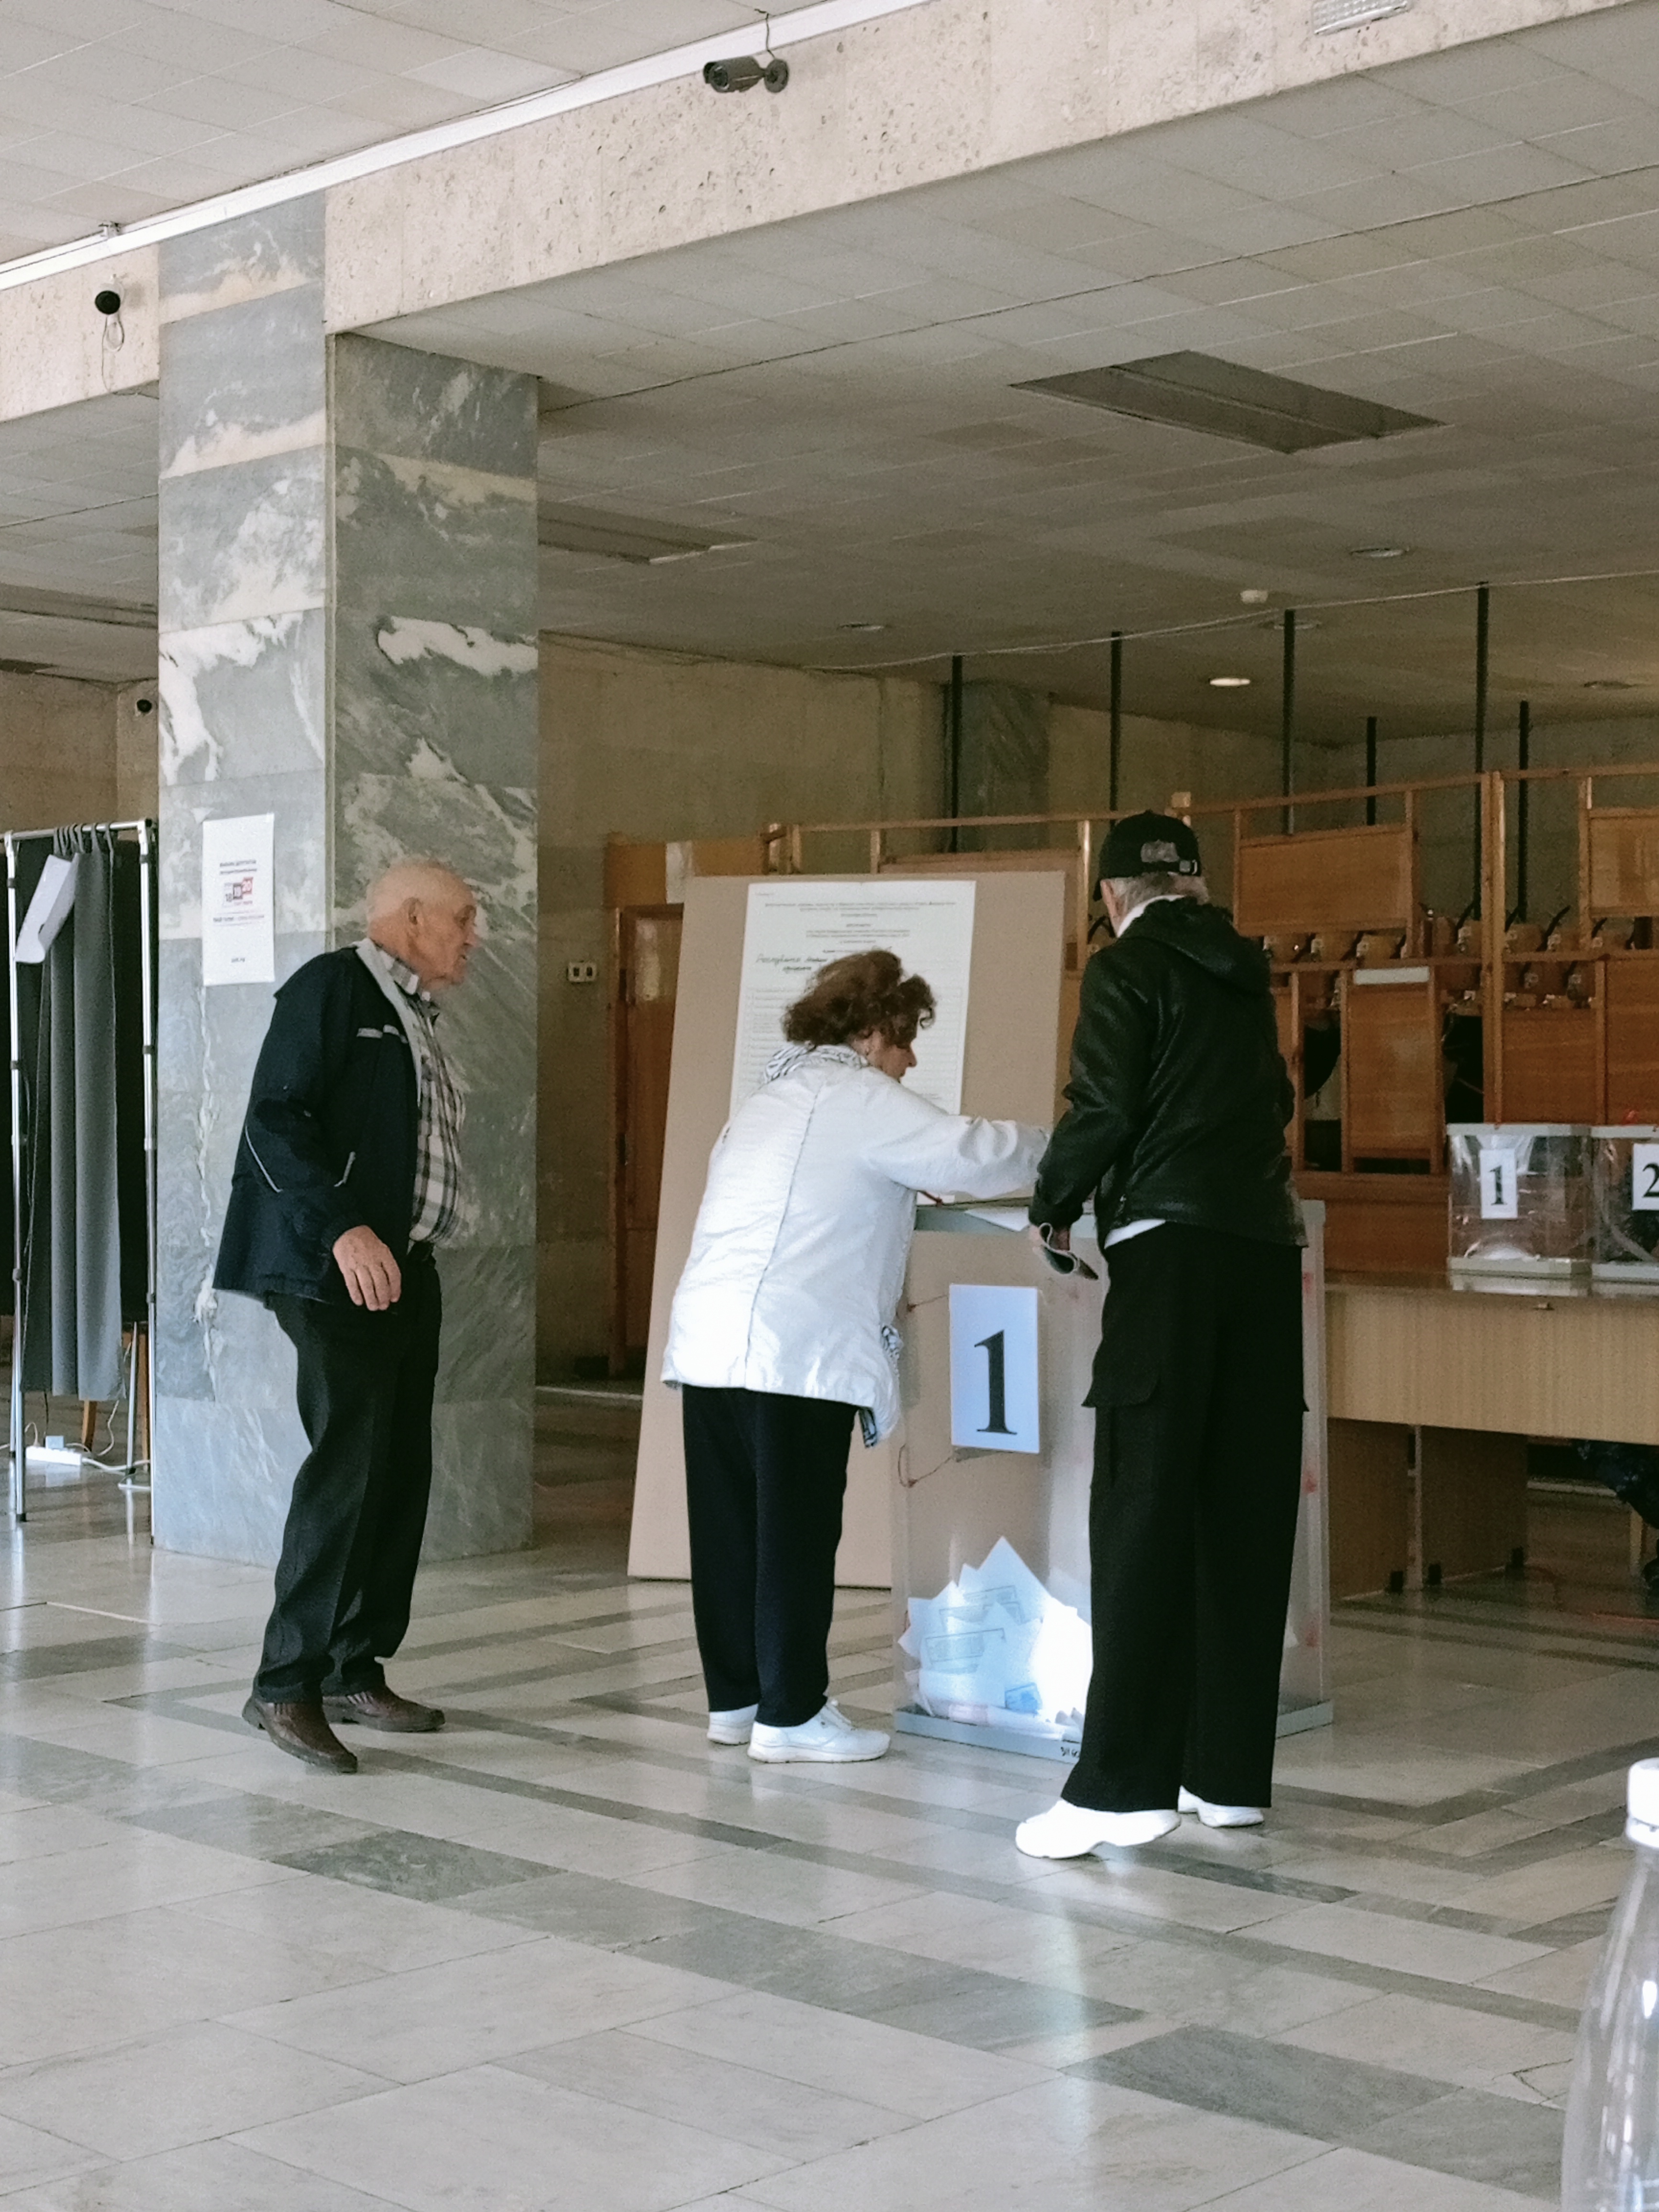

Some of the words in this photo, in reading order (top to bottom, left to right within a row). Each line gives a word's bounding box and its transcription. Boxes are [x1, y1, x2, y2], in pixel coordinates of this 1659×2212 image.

[1489, 1165, 1508, 1206] 1
[1642, 1163, 1659, 1197] 2
[974, 1329, 1018, 1435] 1
